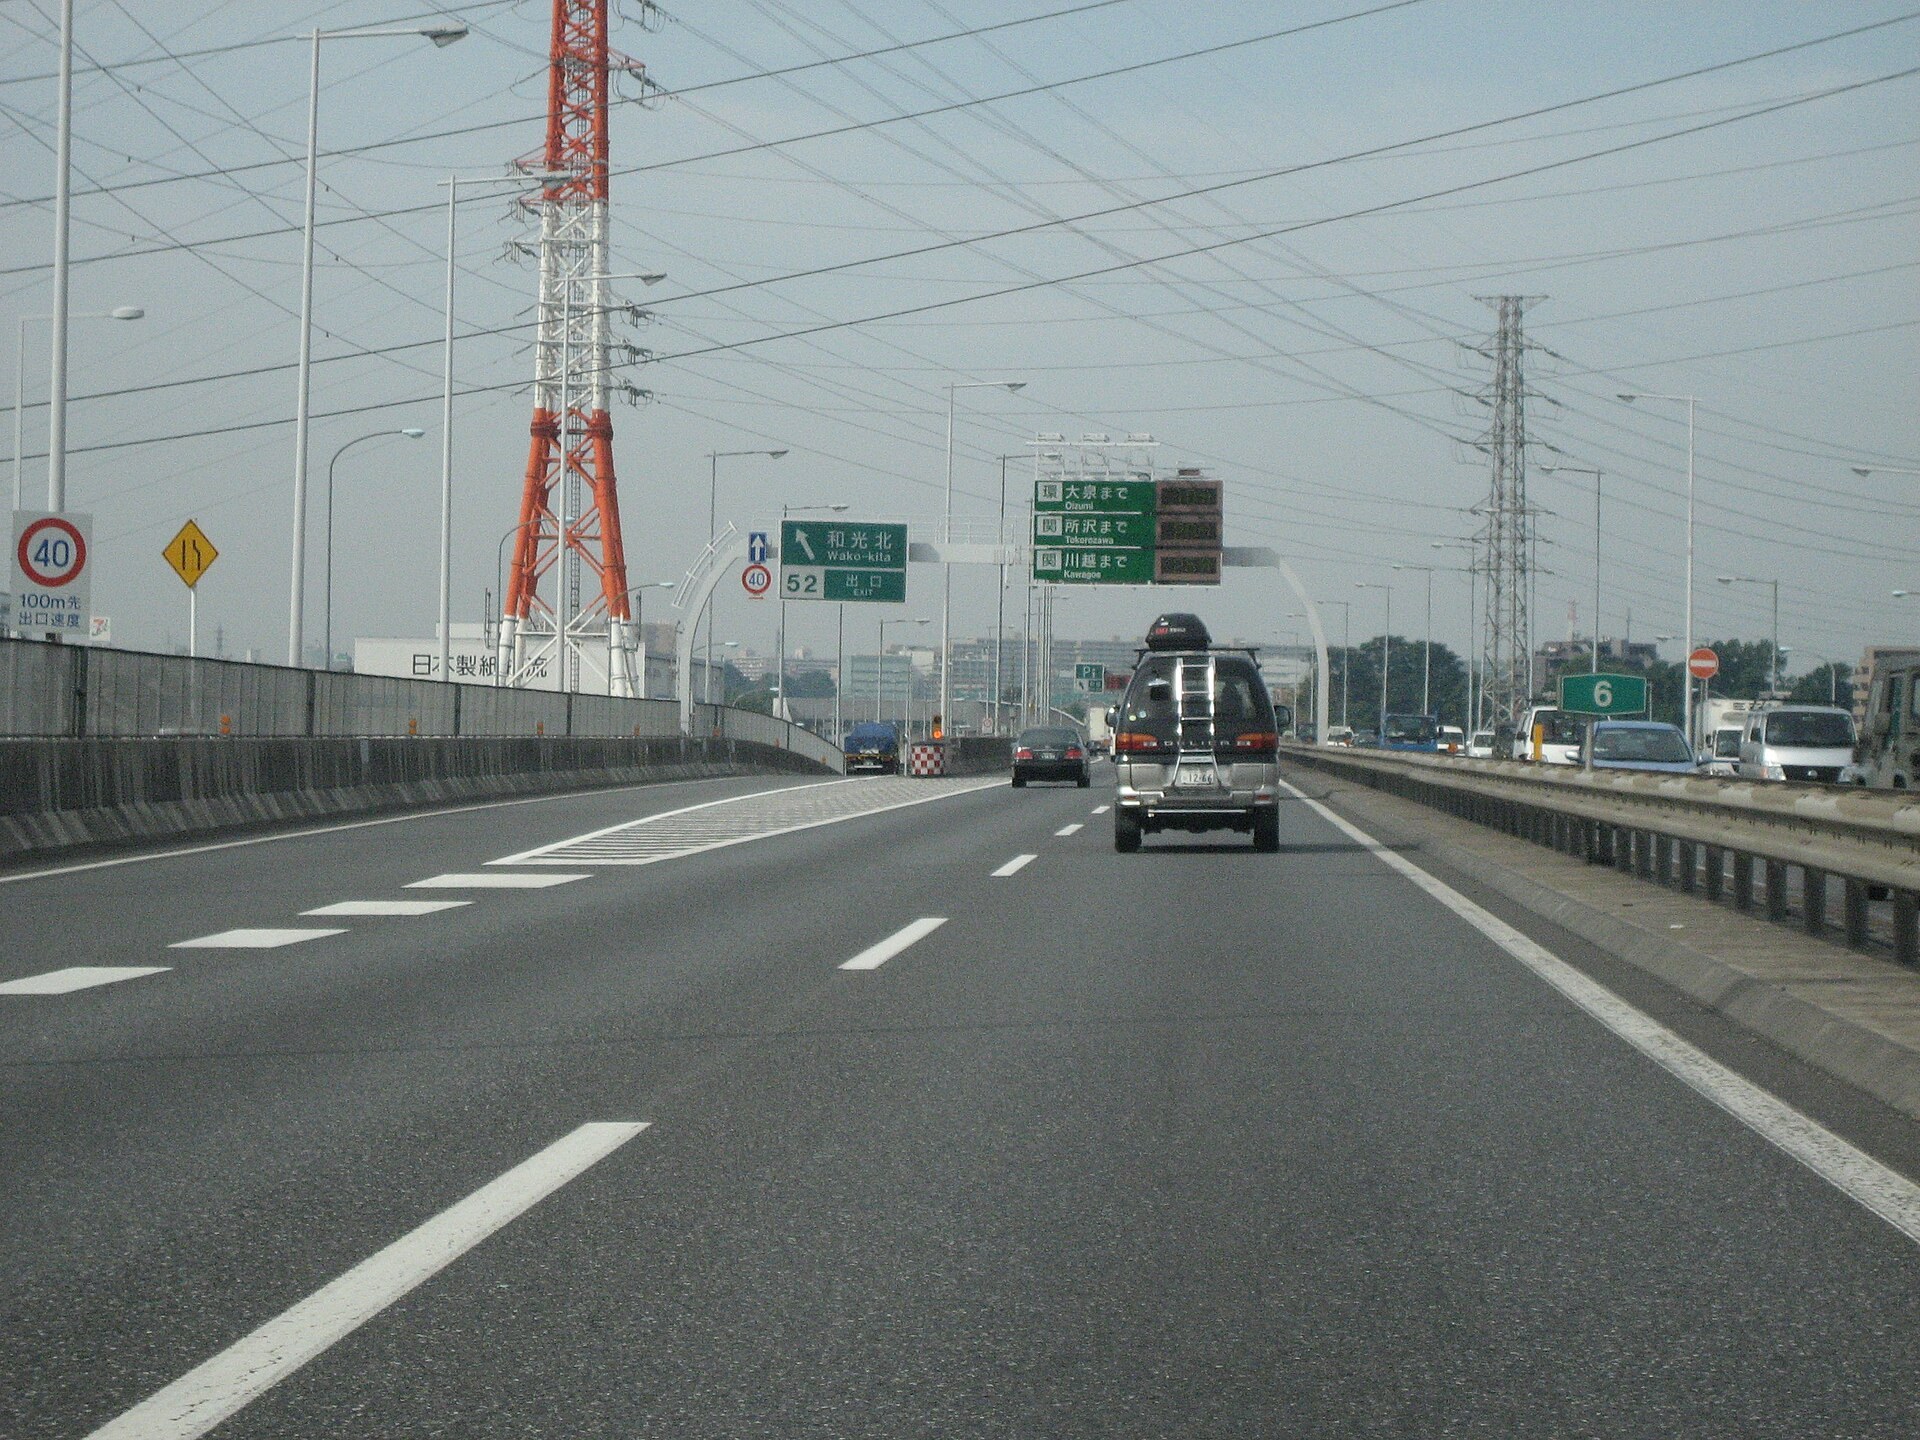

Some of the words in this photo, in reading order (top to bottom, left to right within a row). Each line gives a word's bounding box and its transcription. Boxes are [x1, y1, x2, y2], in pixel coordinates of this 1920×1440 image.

[1065, 484, 1129, 500] 大泉まで
[1065, 502, 1094, 510] Oizumi
[1065, 519, 1128, 534] 所沢まで
[826, 531, 892, 550] 和光北
[1065, 535, 1114, 545] Tokorozawa
[34, 539, 69, 567] 40
[827, 551, 892, 562] Wako-kita
[1065, 553, 1128, 568] 川越まで
[748, 572, 765, 586] 40
[846, 574, 882, 588] 出口
[1063, 570, 1101, 579] Kawagoe
[787, 574, 818, 593] 52
[853, 588, 873, 597] EXIT
[19, 612, 79, 628] 出口速度
[413, 654, 547, 678] 日本製紙流
[1594, 681, 1612, 707] 6
